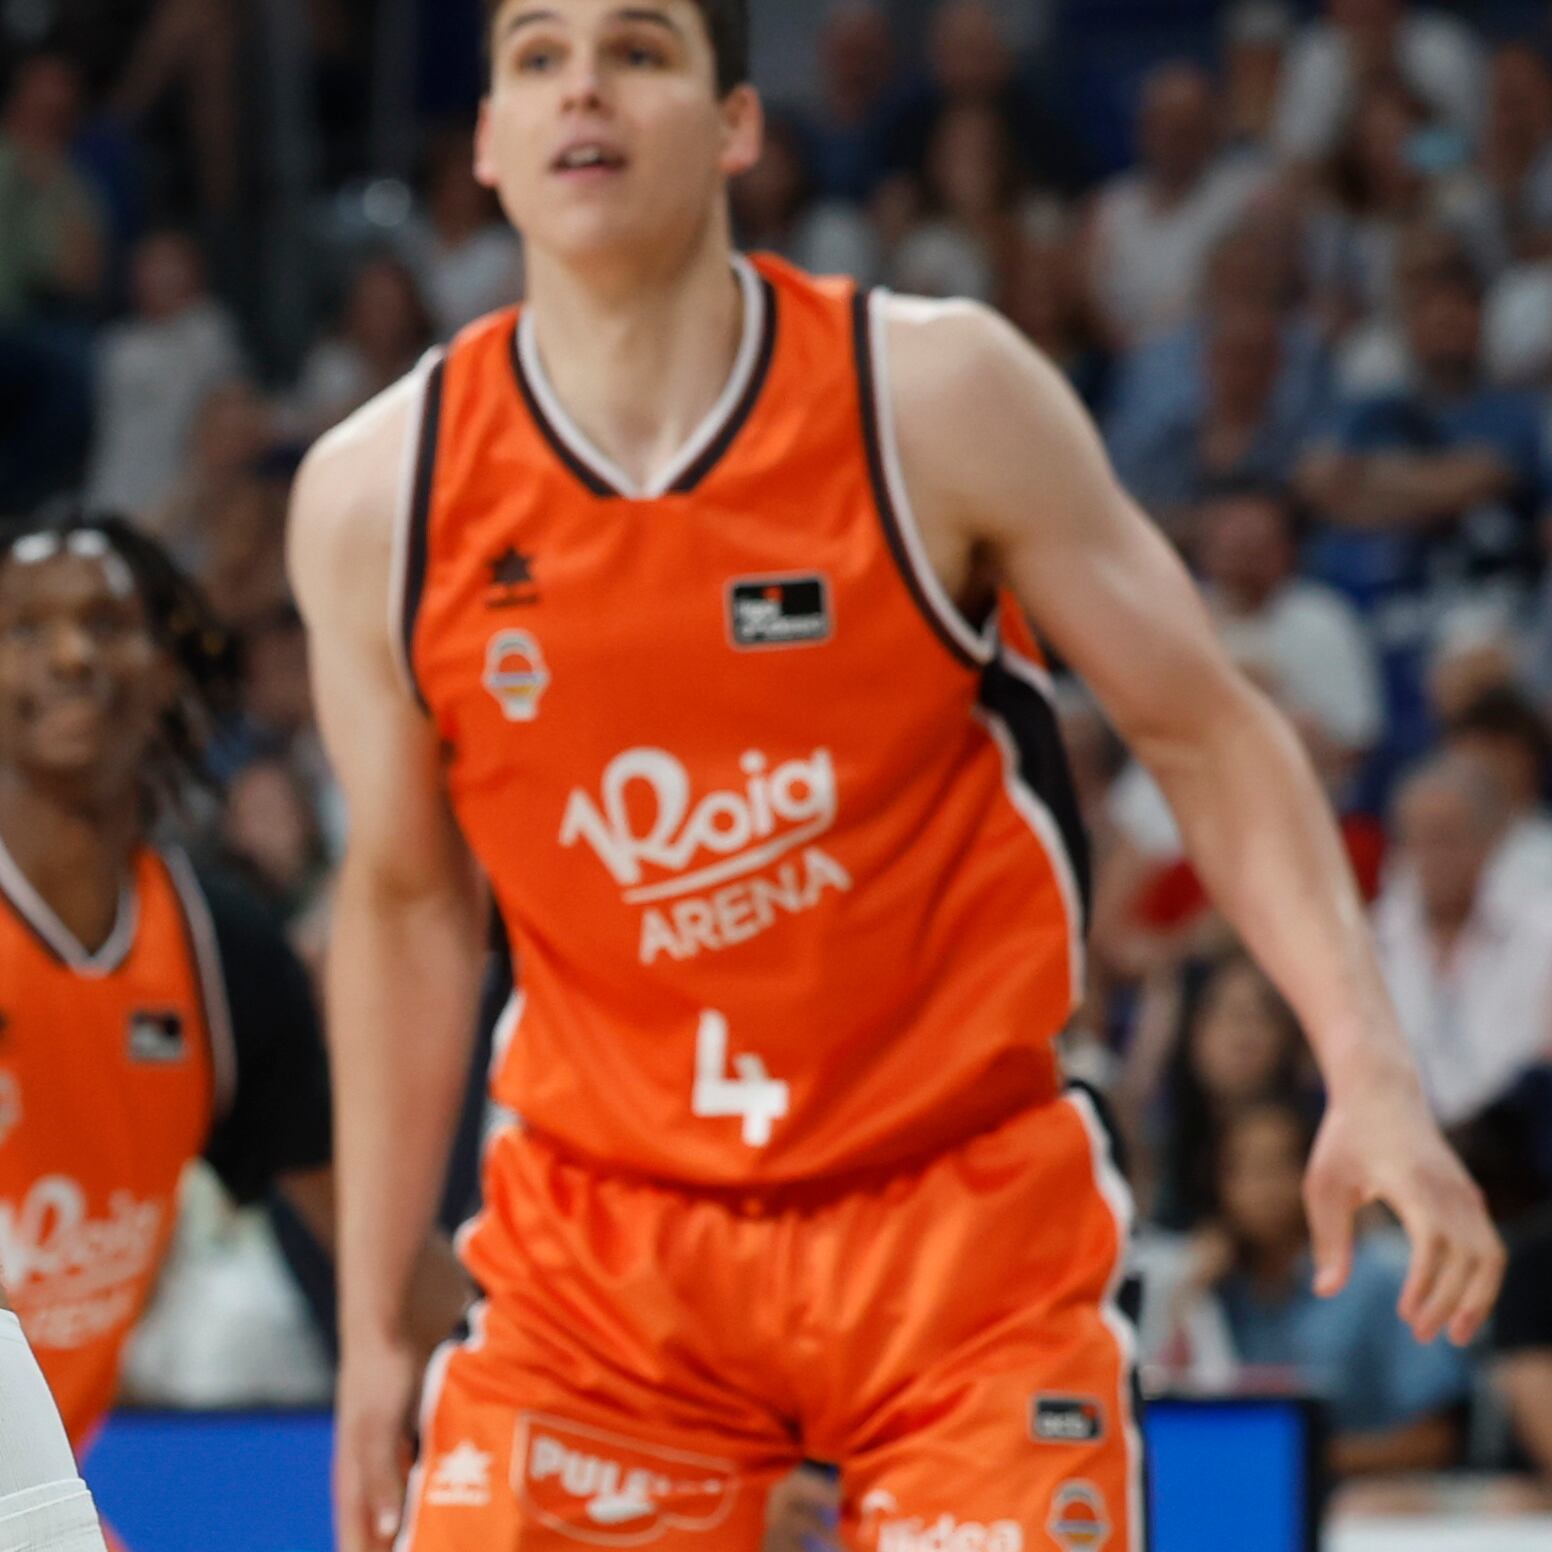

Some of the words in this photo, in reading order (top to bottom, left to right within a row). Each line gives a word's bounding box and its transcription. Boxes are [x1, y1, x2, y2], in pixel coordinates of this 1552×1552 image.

[555, 744, 839, 906] Roig
[638, 845, 855, 966] ARENA
[691, 1008, 789, 1147] 4
